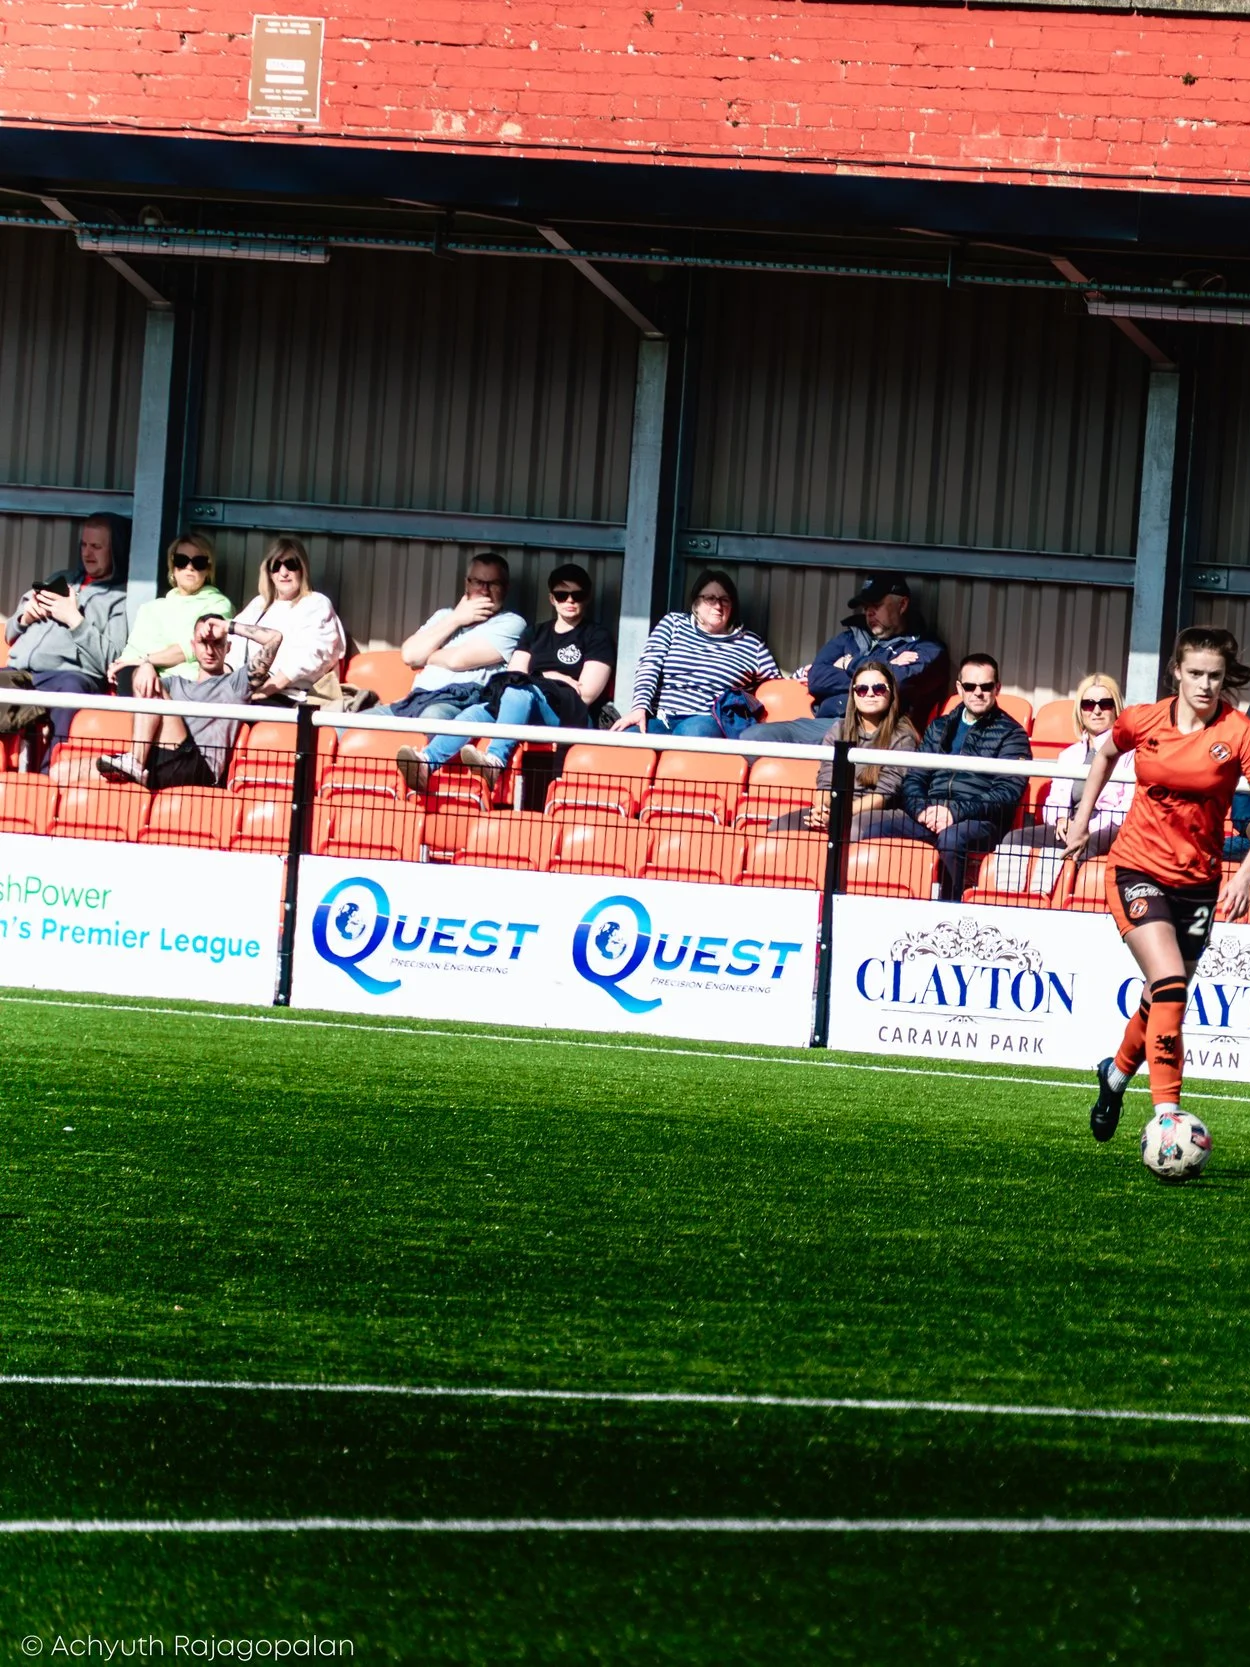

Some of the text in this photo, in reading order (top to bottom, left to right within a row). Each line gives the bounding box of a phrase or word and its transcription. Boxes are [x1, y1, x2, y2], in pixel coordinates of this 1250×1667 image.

[41, 918, 150, 950] Premier
[160, 927, 261, 964] League
[705, 981, 772, 994] ENGINEERING
[856, 957, 1075, 1015] CLAYTON
[878, 1025, 1045, 1055] CARAVAN PARK
[1184, 1049, 1240, 1069] AVAN
